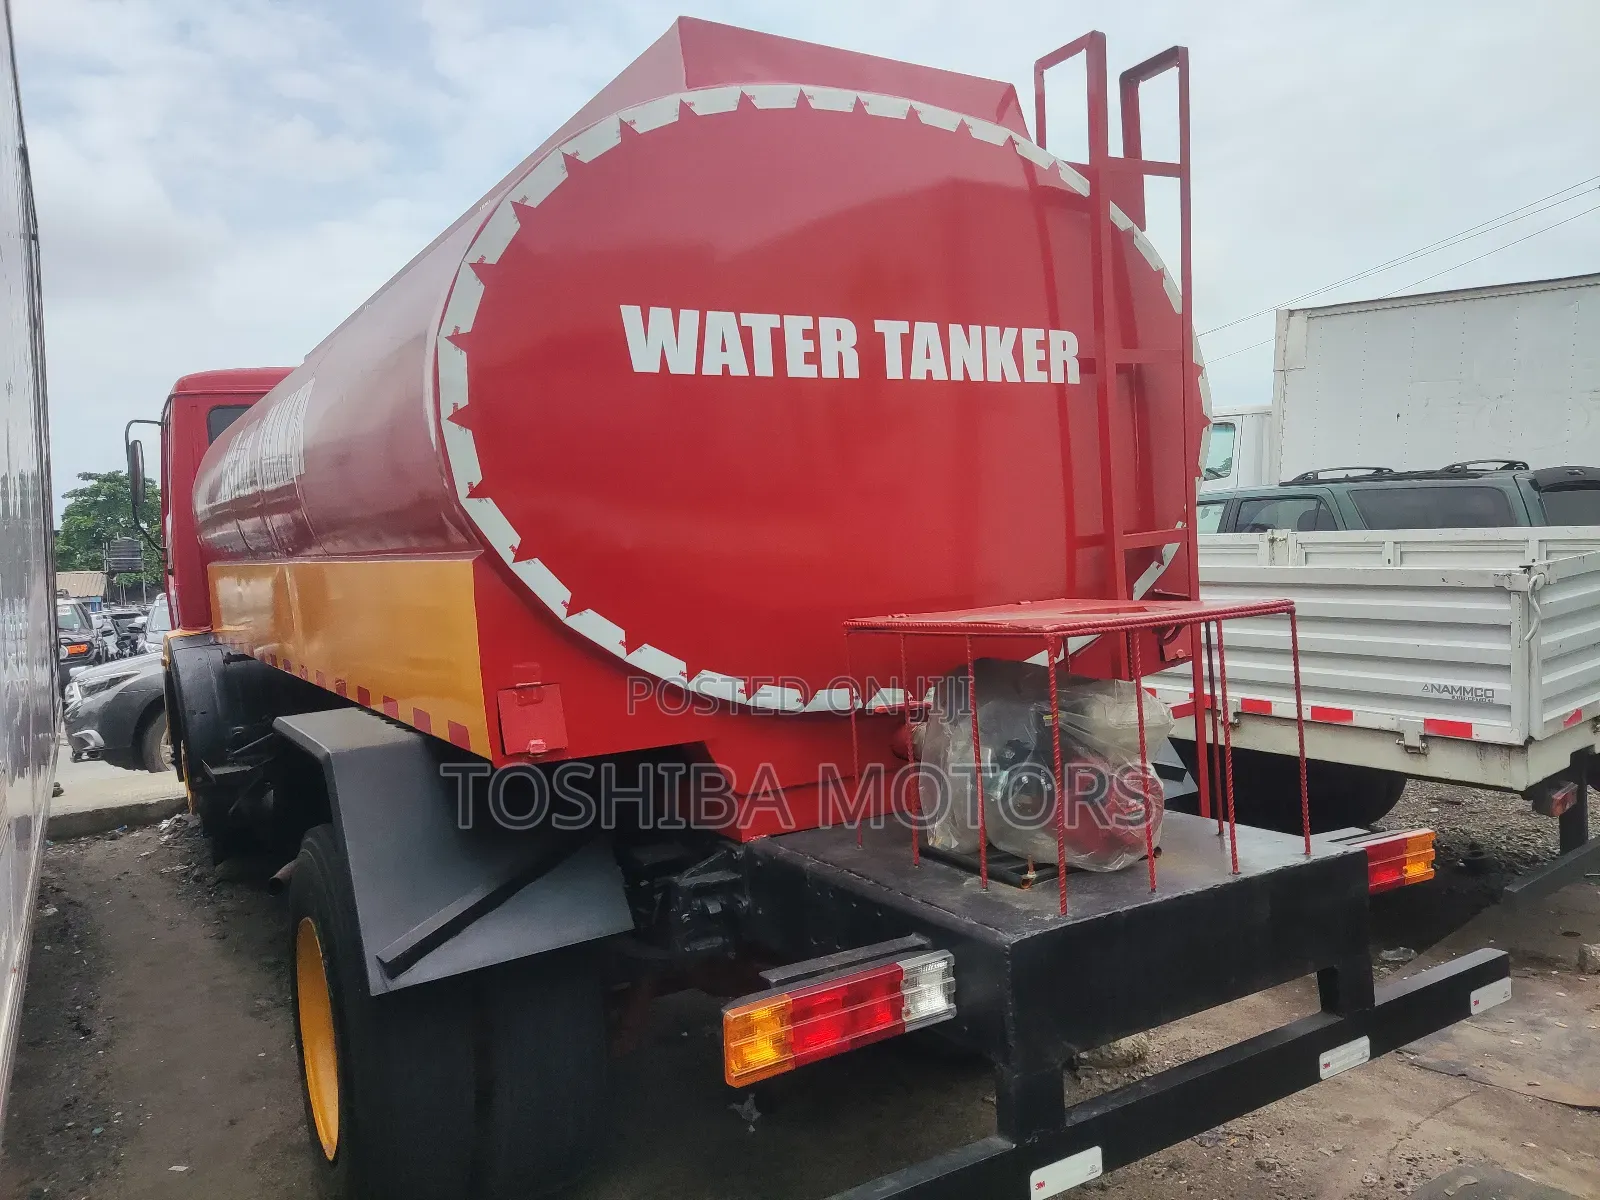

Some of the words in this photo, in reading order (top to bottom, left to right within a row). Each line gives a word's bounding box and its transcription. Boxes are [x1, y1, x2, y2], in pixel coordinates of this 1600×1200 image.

[619, 304, 860, 379] WATER
[873, 319, 1081, 385] TANKER
[1430, 683, 1495, 699] NAMMCO
[1034, 1180, 1046, 1191] 3M
